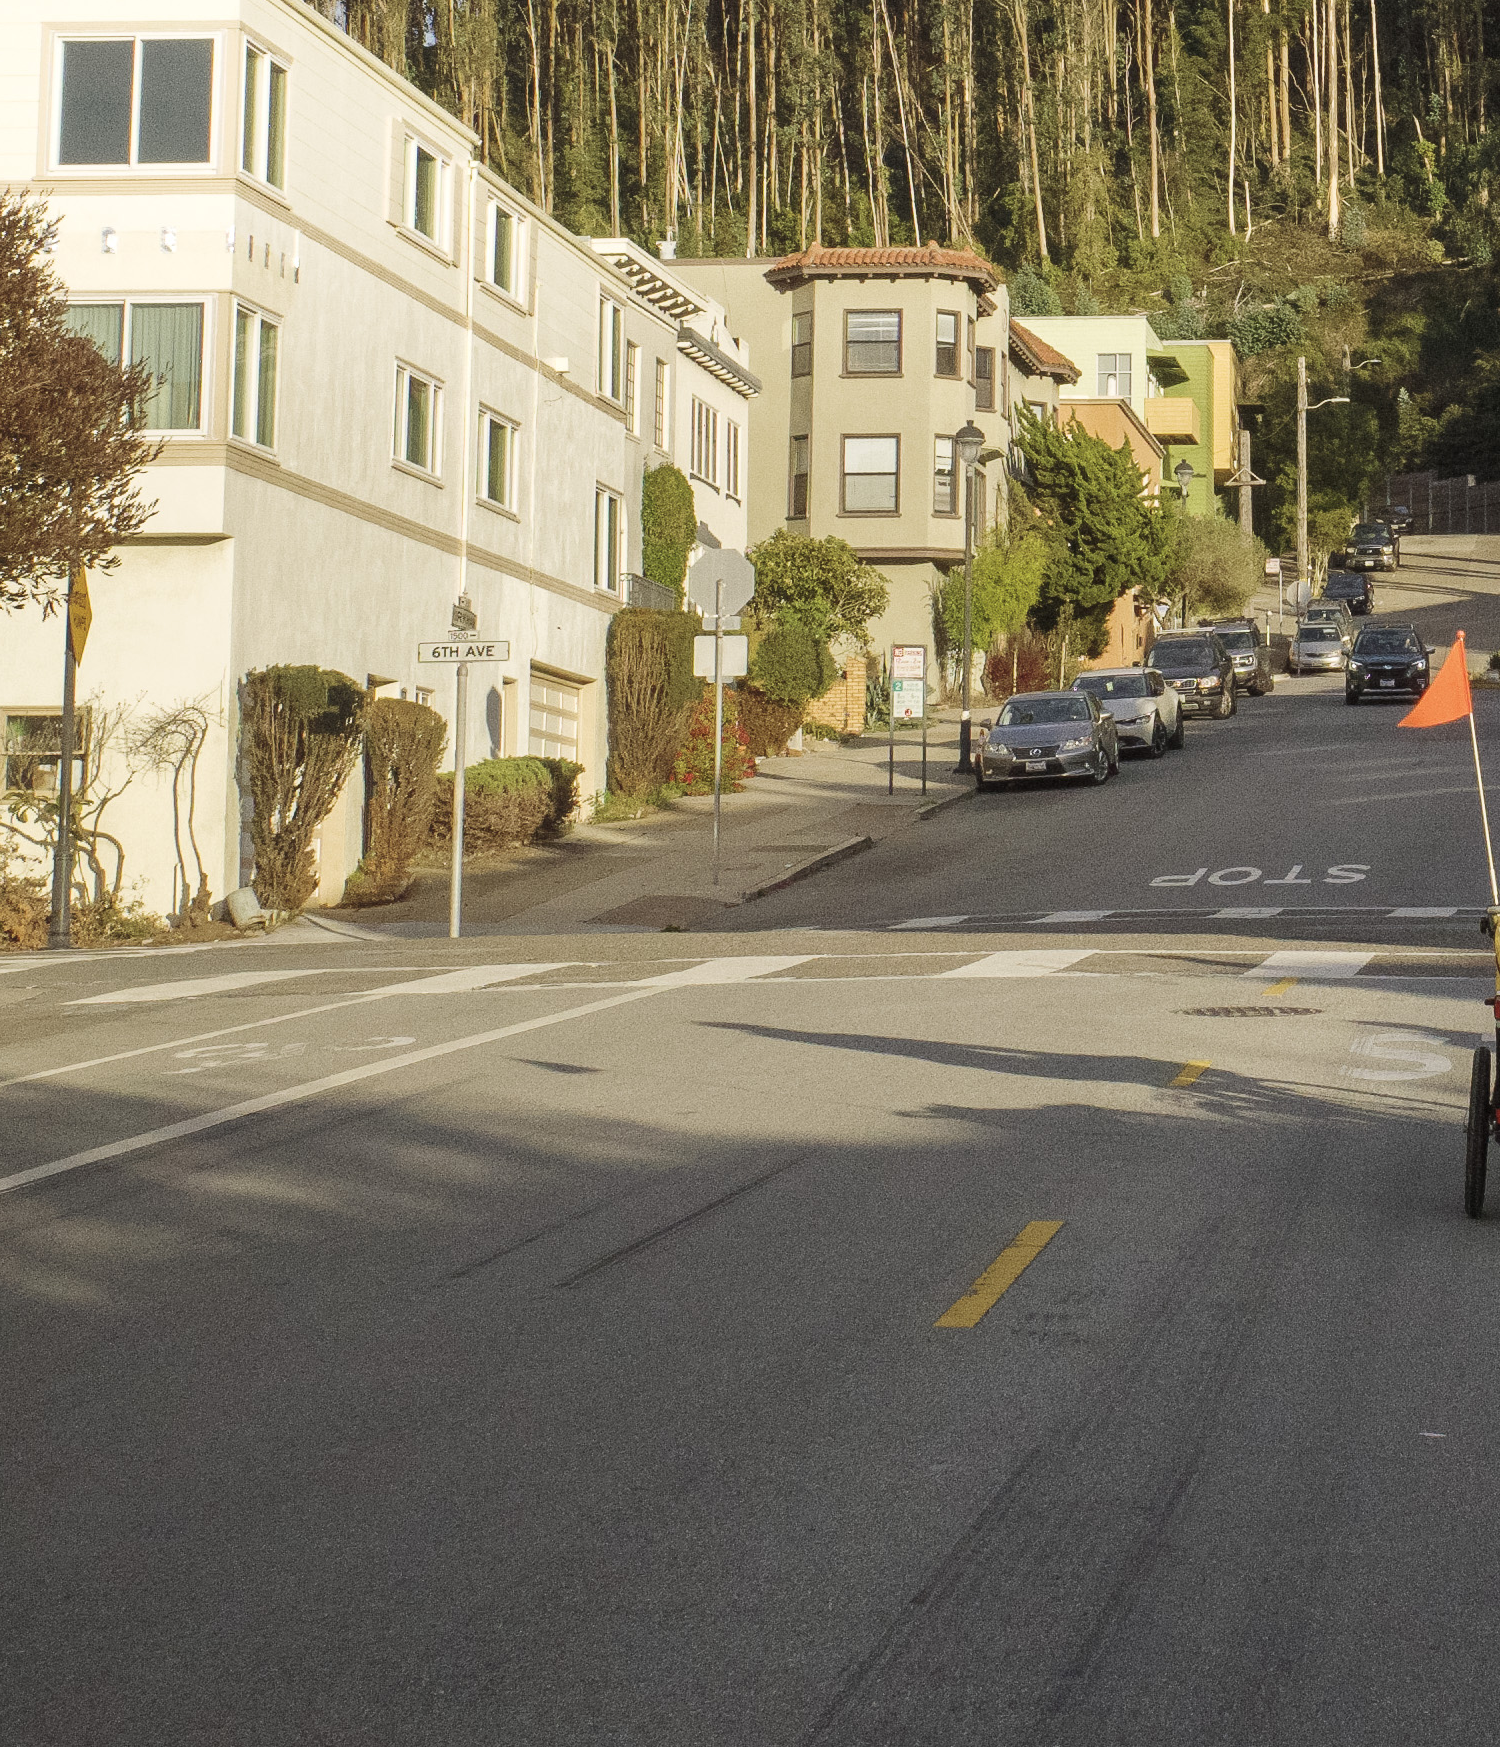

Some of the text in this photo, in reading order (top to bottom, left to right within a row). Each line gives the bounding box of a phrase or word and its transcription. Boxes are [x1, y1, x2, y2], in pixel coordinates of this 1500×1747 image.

[450, 632, 469, 640] 1500
[431, 645, 495, 659] 6TH AVE
[1149, 864, 1372, 887] STOP
